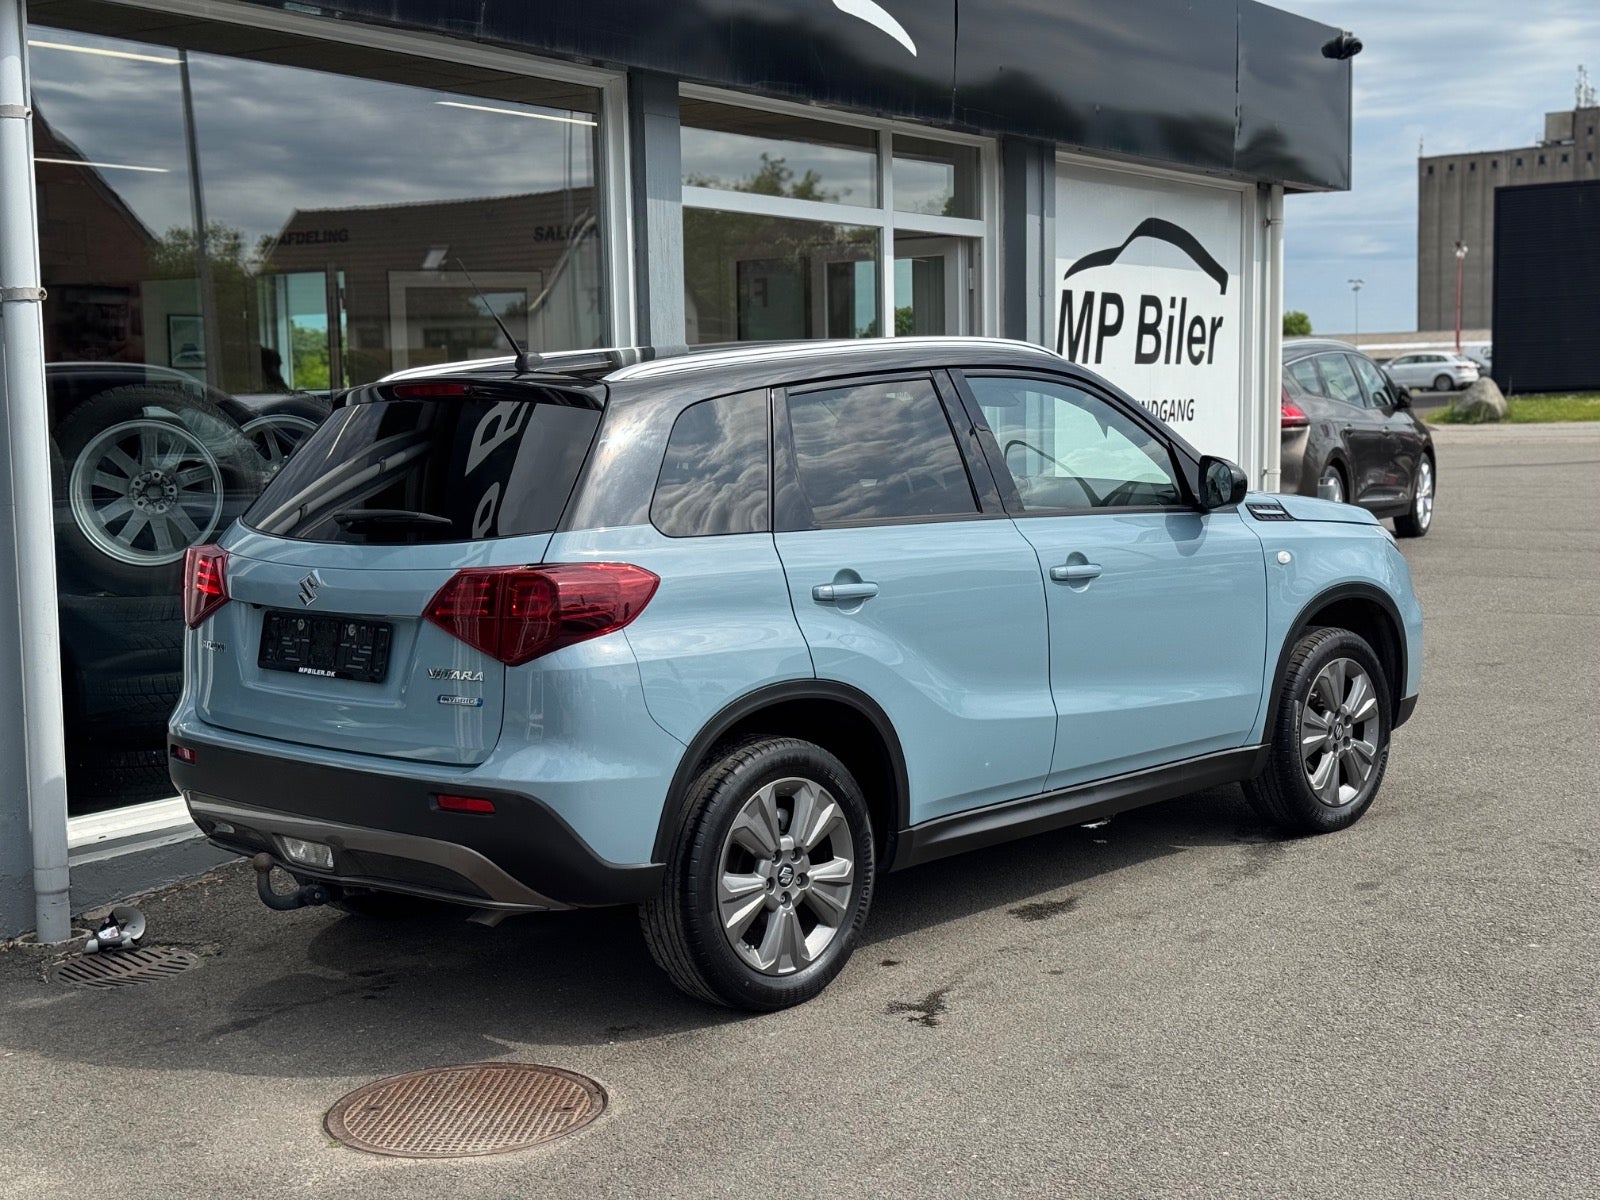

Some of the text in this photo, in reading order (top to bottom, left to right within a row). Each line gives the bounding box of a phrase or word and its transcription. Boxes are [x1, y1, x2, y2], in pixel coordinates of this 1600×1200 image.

[278, 228, 349, 246] AFDELING
[1056, 289, 1224, 366] MP Biler
[1138, 399, 1195, 422] NDGANG
[298, 666, 336, 677] MPBILER.DK
[428, 668, 484, 682] VITARA
